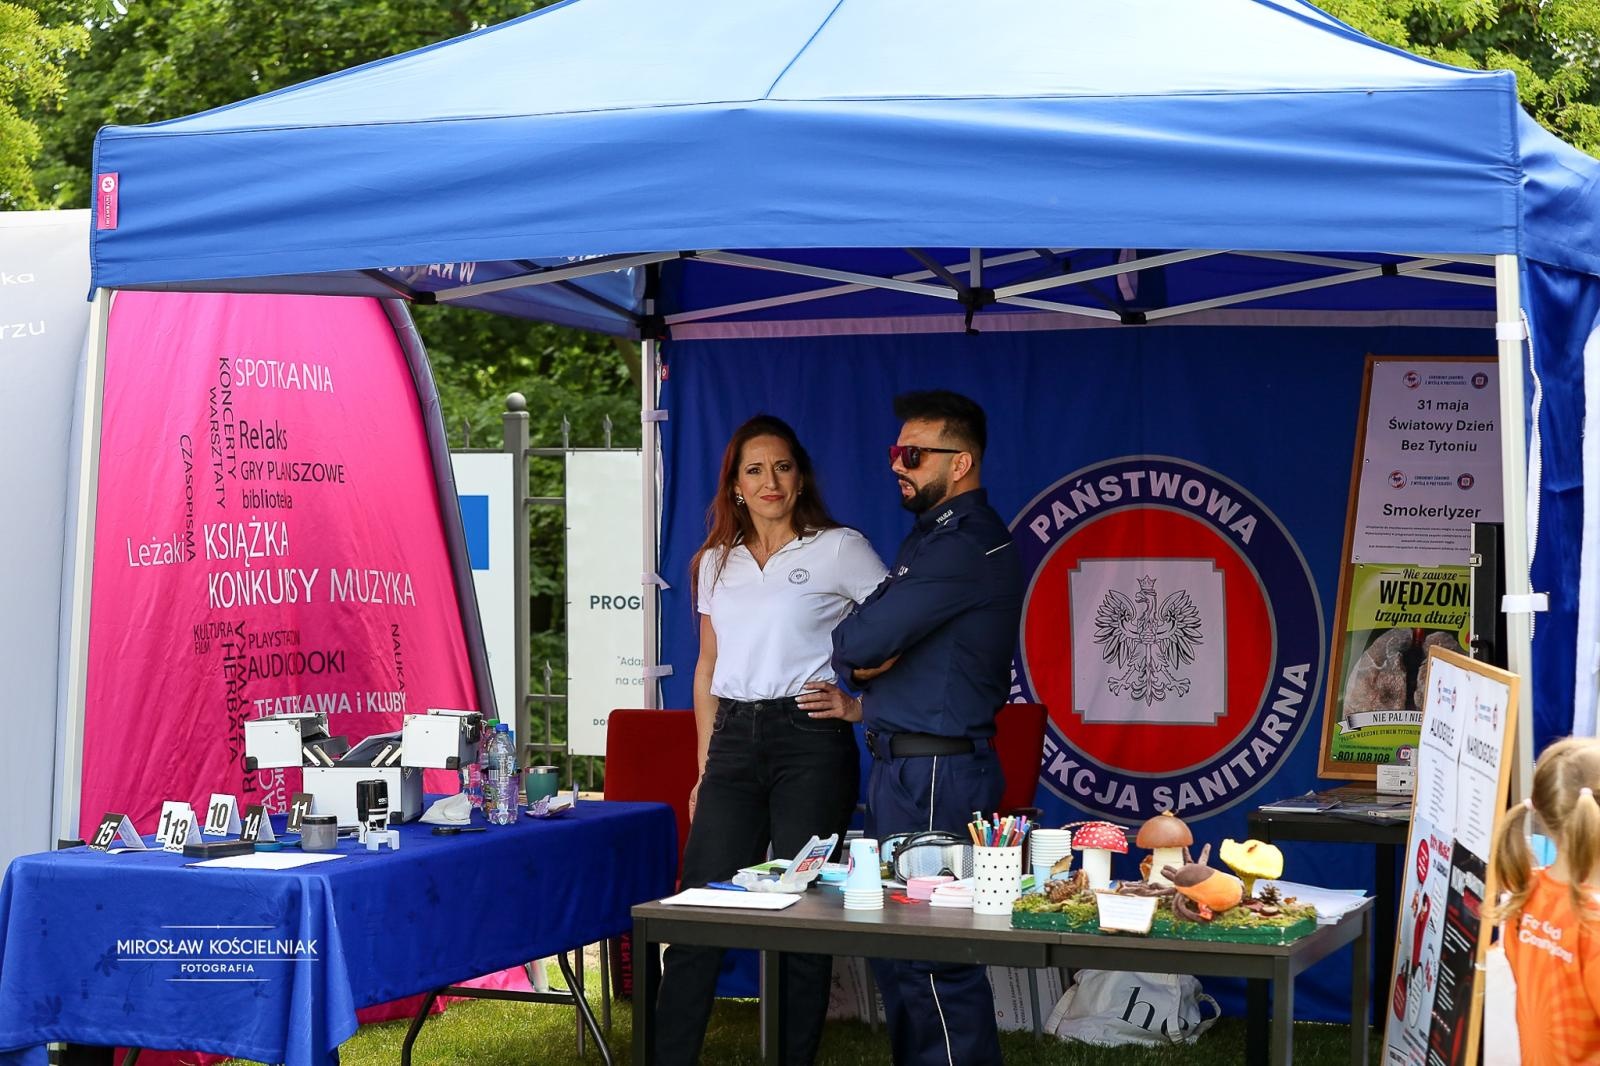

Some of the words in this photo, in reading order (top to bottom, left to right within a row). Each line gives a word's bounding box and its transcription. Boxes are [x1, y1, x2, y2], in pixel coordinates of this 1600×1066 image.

[235, 358, 334, 393] SPOTKANIA
[219, 357, 236, 479] KONCERTY
[1417, 400, 1432, 410] 31
[1436, 400, 1469, 412] maja
[240, 420, 287, 450] Relaks
[1388, 417, 1453, 433] Światowy
[1456, 419, 1494, 432] Dzień
[209, 386, 226, 509] WARSZTATY
[1401, 440, 1425, 451] Bez
[1428, 440, 1478, 453] Tytoniu
[241, 461, 264, 480] GRY
[267, 461, 345, 483] PLANSZOWE
[180, 434, 196, 562] CZASOPISMA
[1029, 470, 1258, 545] PAŃSTWOWA
[1383, 503, 1482, 520] Smokerlyzer
[127, 533, 185, 567] Leżaki
[203, 515, 289, 567] KSIĄŻKA
[1402, 568, 1420, 579] Nie
[1422, 571, 1458, 581] zawsze
[208, 568, 319, 609] KONKURSY
[330, 568, 416, 606] MUZYKA
[590, 595, 644, 610] PROG
[193, 621, 234, 641] KULTURA
[1375, 609, 1421, 626] trzyma
[391, 624, 405, 691] NAUKA
[220, 642, 239, 764] HERBATA
[356, 691, 362, 713] i
[366, 691, 407, 713] KLUBY
[1373, 713, 1387, 723] NIE
[1152, 662, 1311, 813] SANITARNA
[210, 802, 229, 828] 10
[243, 813, 260, 840] 14
[95, 820, 118, 846] 15
[170, 818, 188, 845] 13
